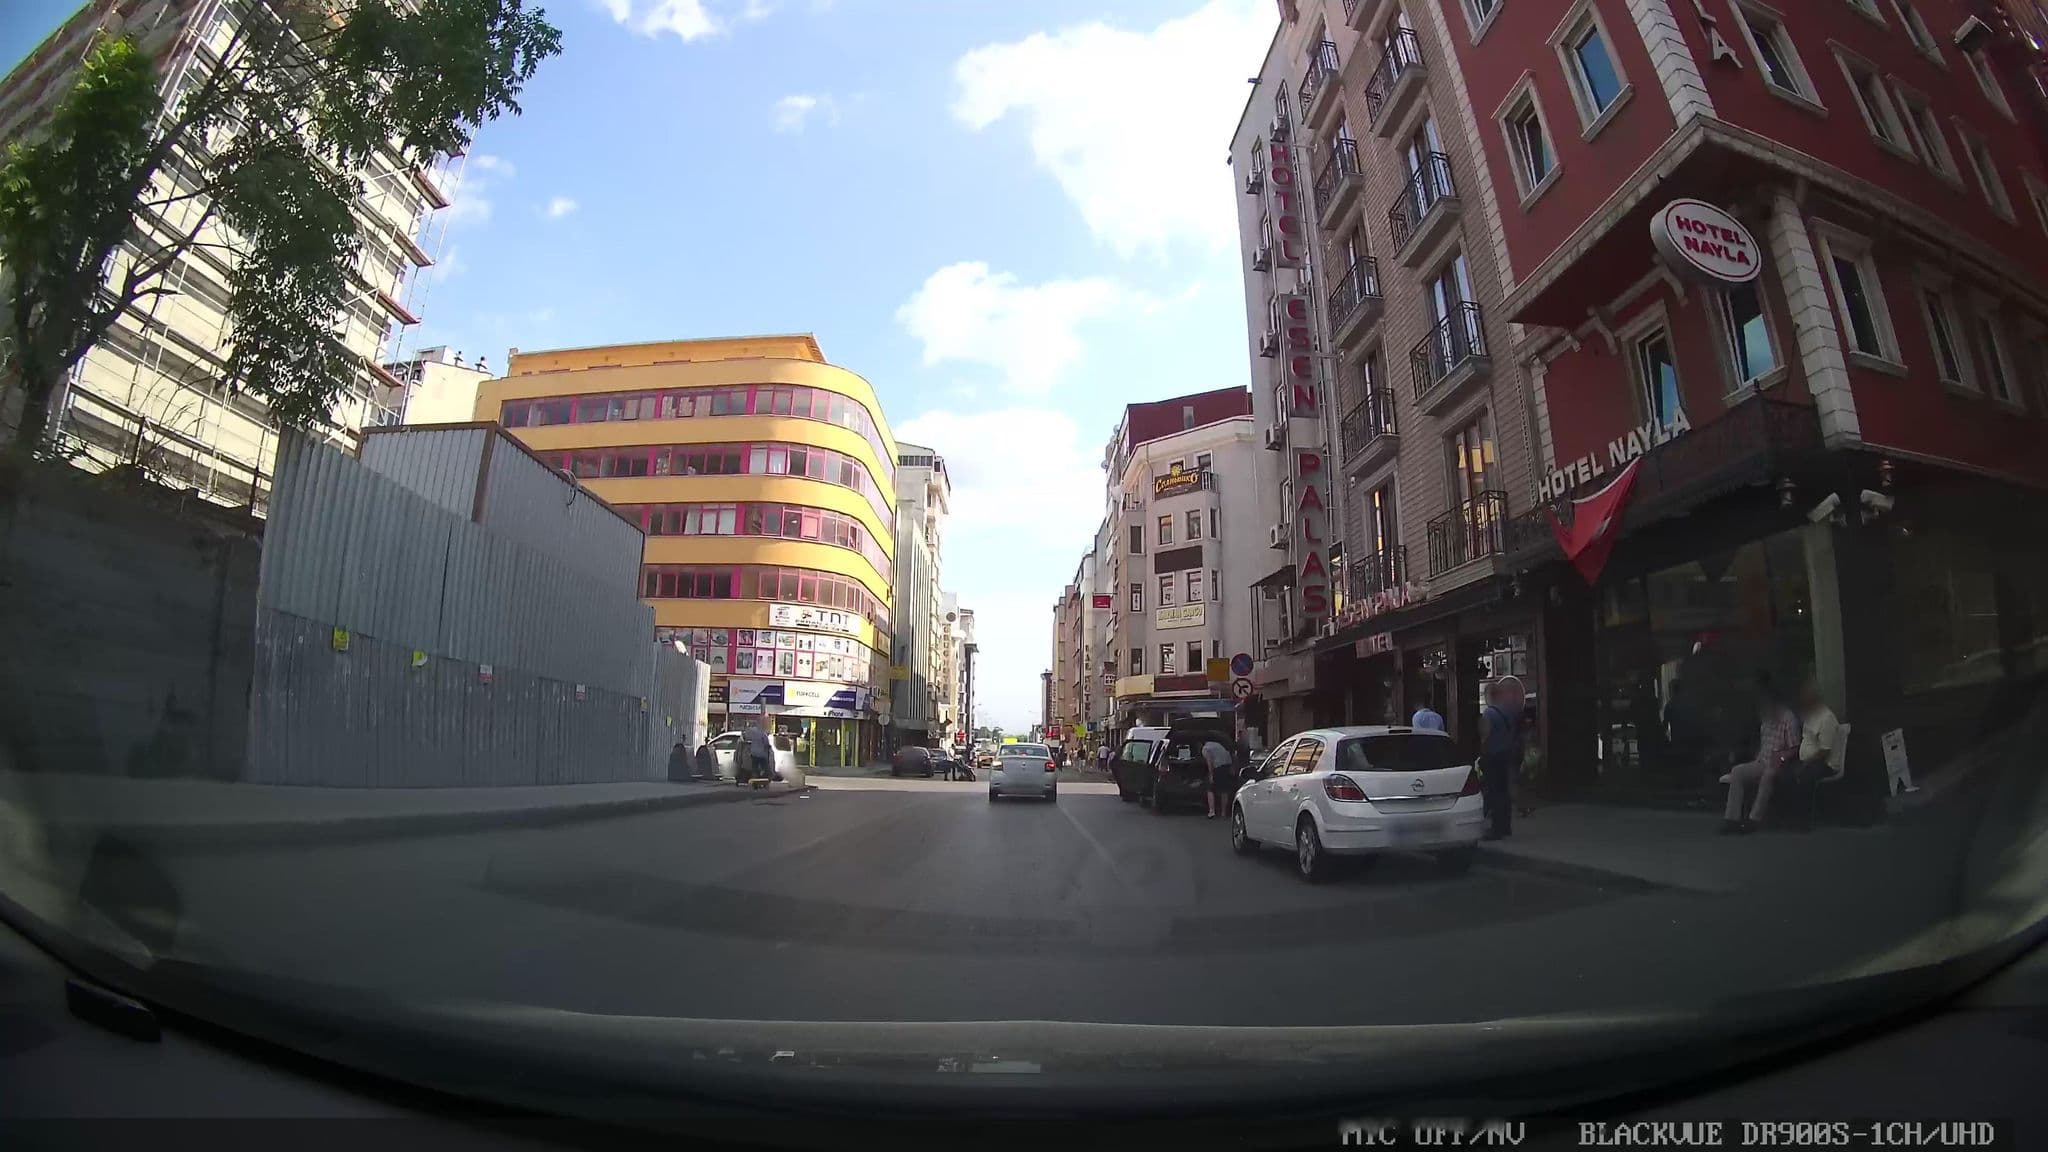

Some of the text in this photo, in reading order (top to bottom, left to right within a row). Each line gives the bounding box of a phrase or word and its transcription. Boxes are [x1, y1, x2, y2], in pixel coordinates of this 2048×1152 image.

[1675, 215, 1747, 247] HOTEL
[1683, 235, 1751, 266] NAYLA
[1270, 142, 1327, 613] HOTEL ESEN PALAS
[1538, 406, 1692, 503] HOTEL NAYLA
